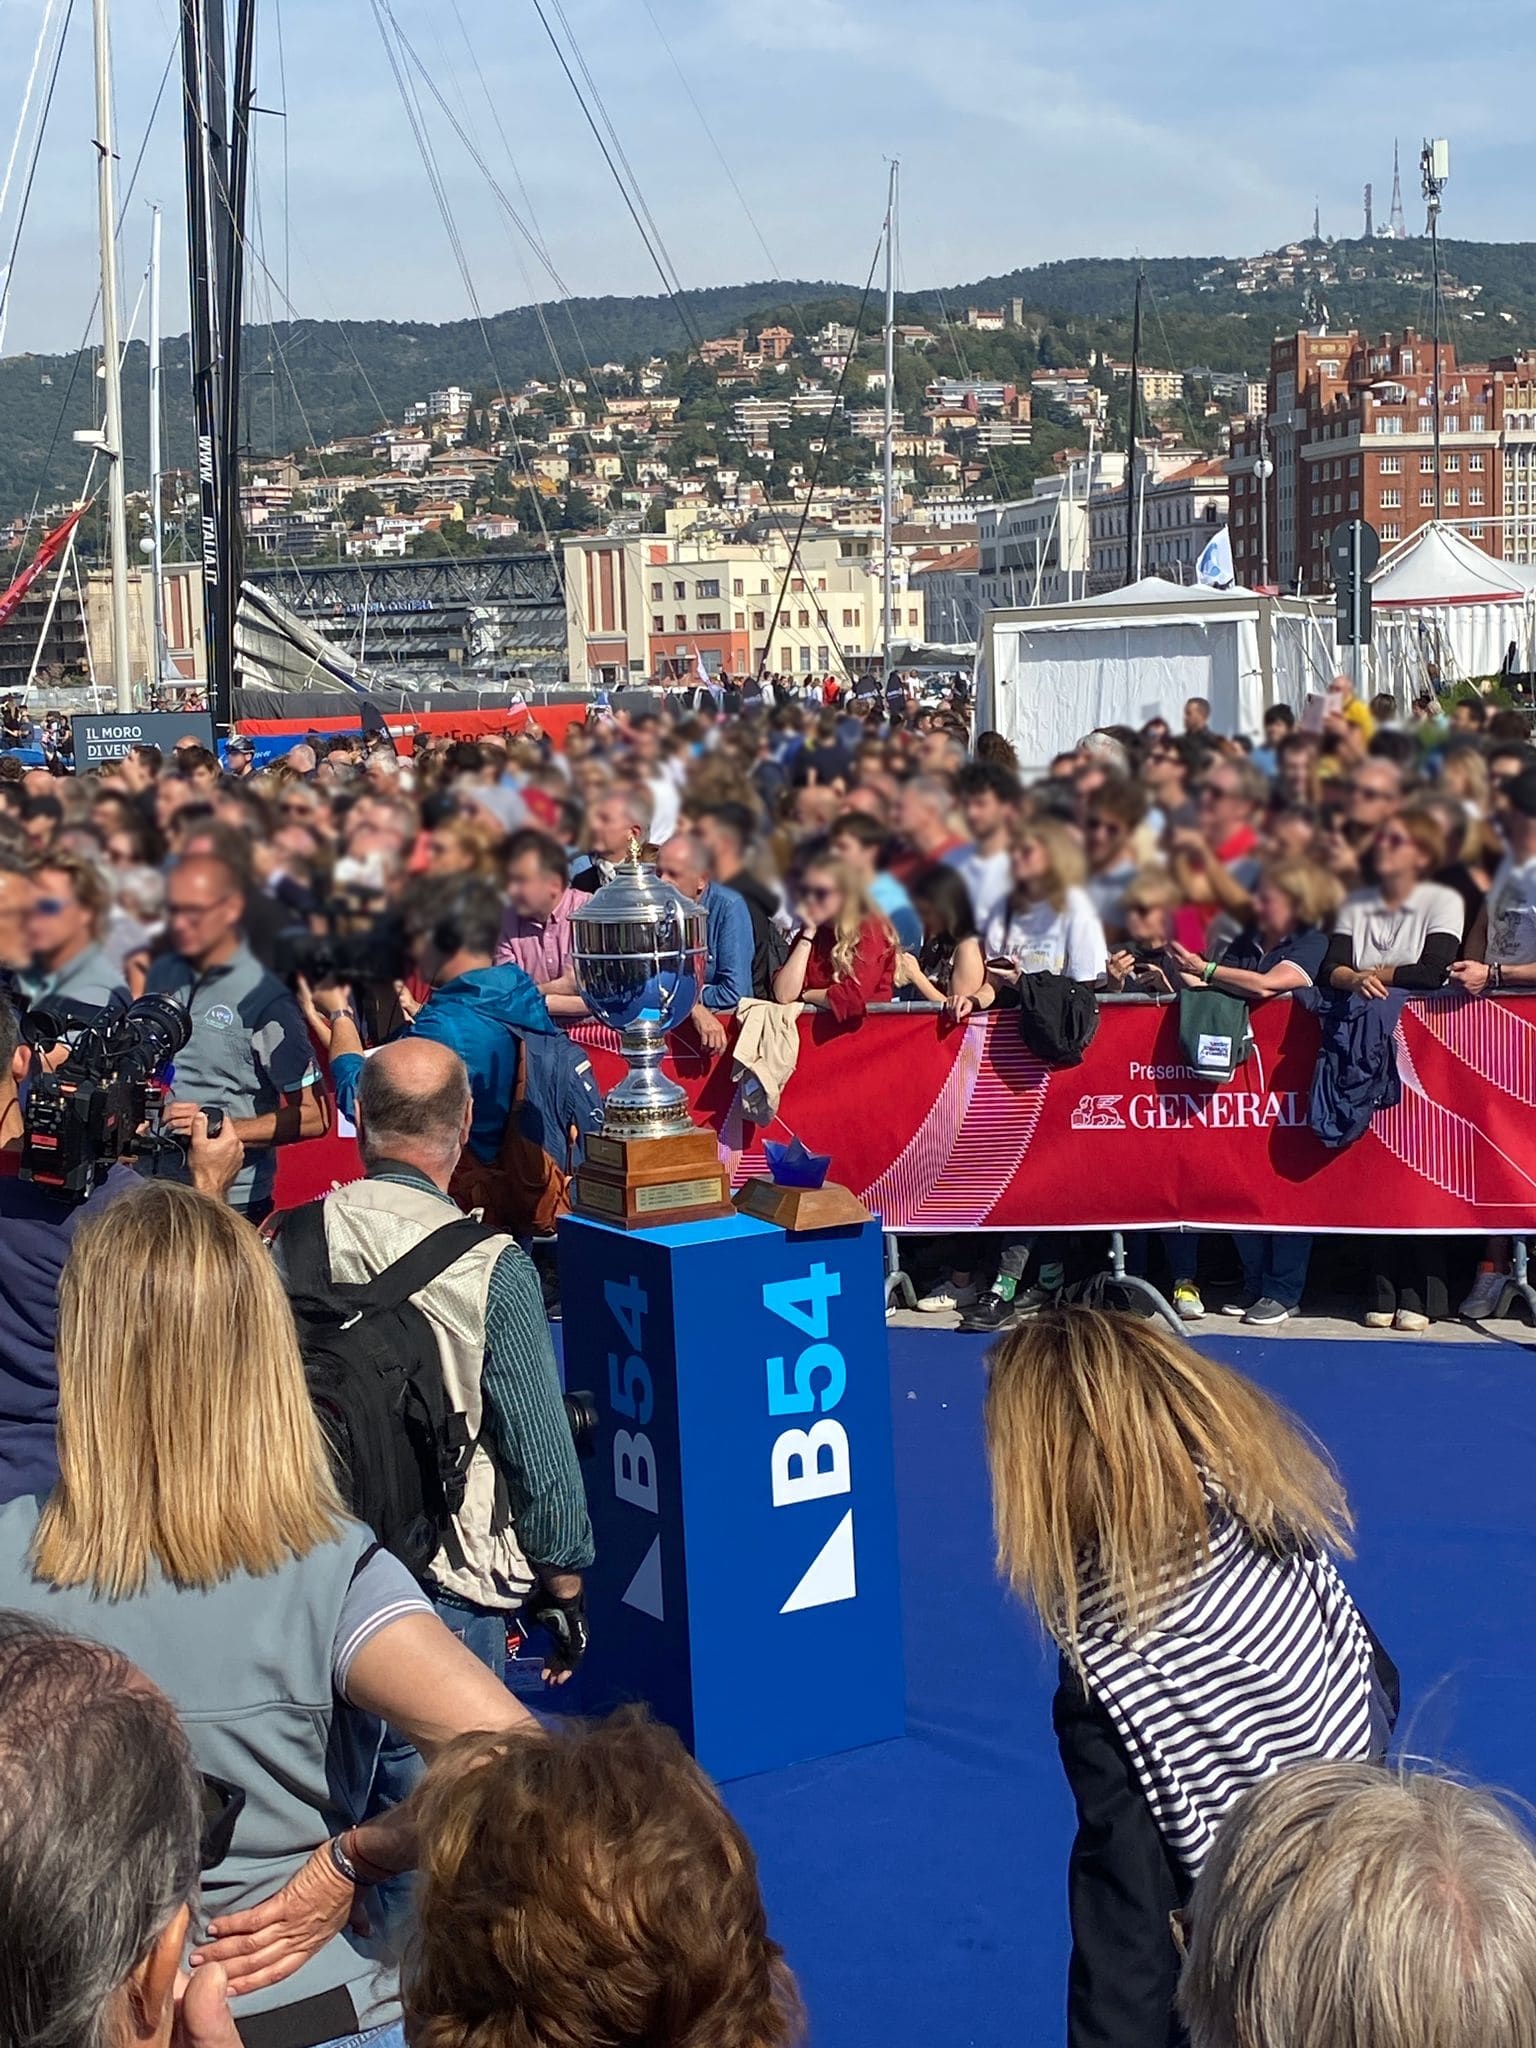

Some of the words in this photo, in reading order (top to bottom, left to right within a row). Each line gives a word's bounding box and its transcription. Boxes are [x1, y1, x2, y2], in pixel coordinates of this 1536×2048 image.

[86, 727, 99, 739] IL
[102, 726, 142, 739] MORO
[88, 745, 102, 757] DI
[1129, 1091, 1308, 1129] GENERAL
[762, 1261, 851, 1508] B54
